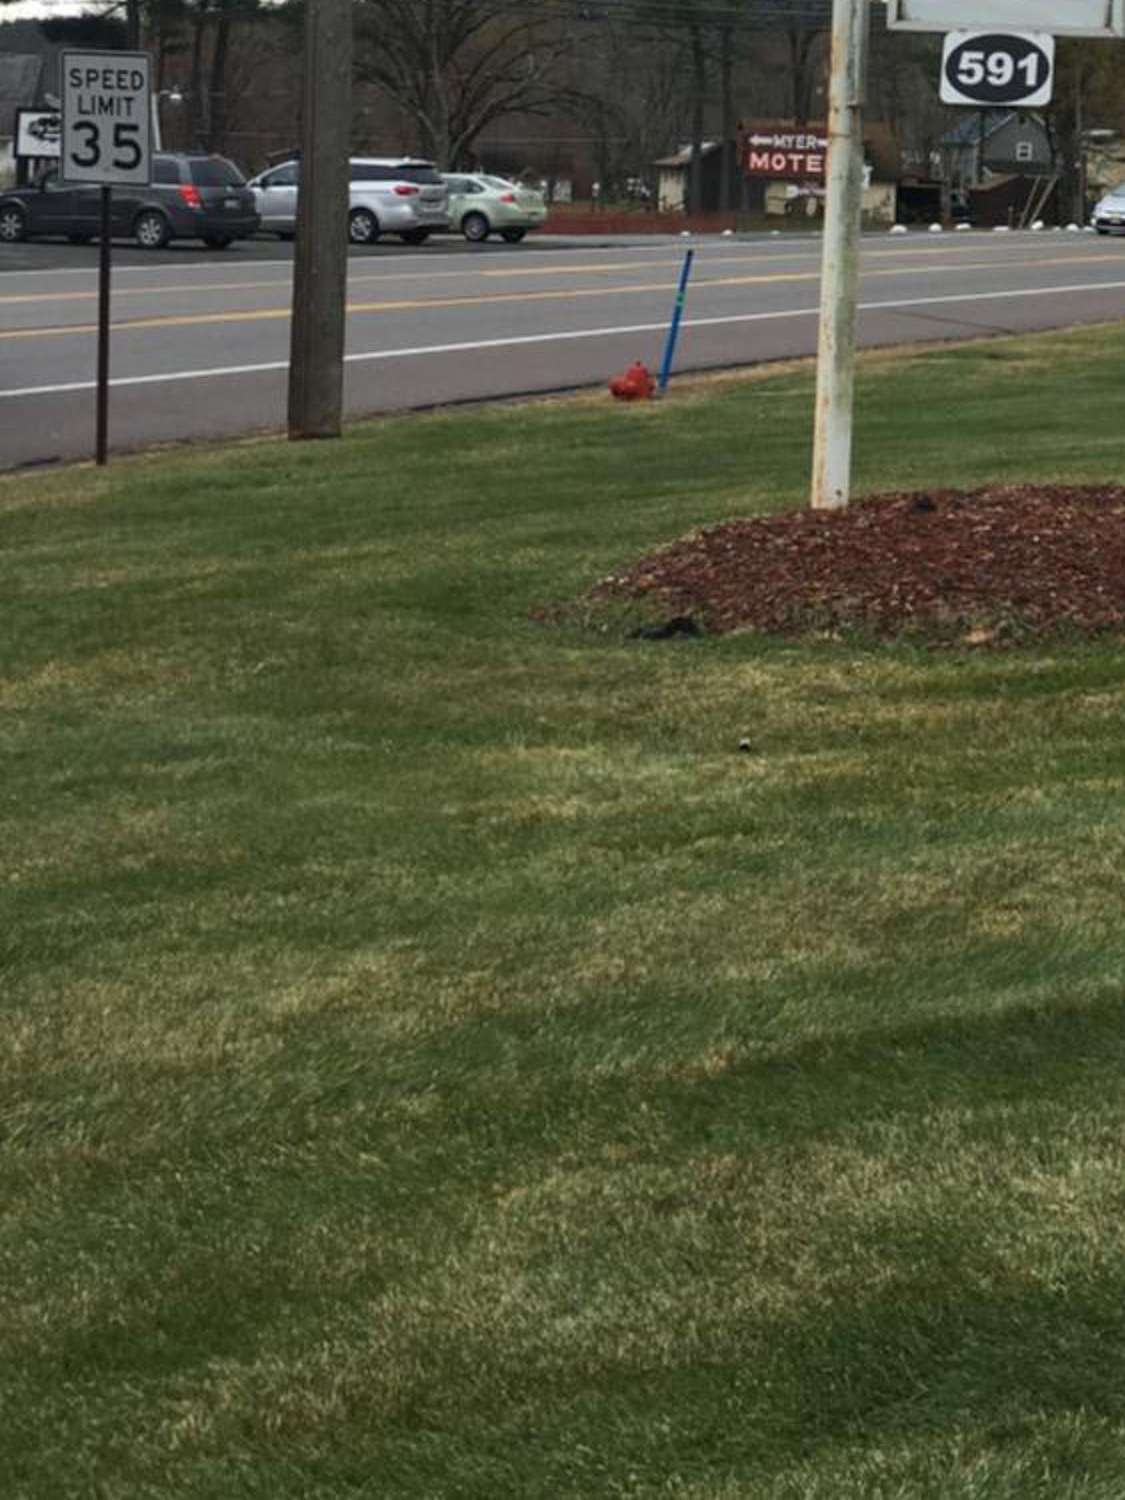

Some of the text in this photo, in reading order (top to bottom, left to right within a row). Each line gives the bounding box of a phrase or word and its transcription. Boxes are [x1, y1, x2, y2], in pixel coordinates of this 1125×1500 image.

[69, 67, 145, 91] SPEED
[956, 50, 1039, 87] 591
[77, 94, 134, 117] LIMIT
[70, 120, 143, 171] 35
[749, 151, 824, 172] MOTE
